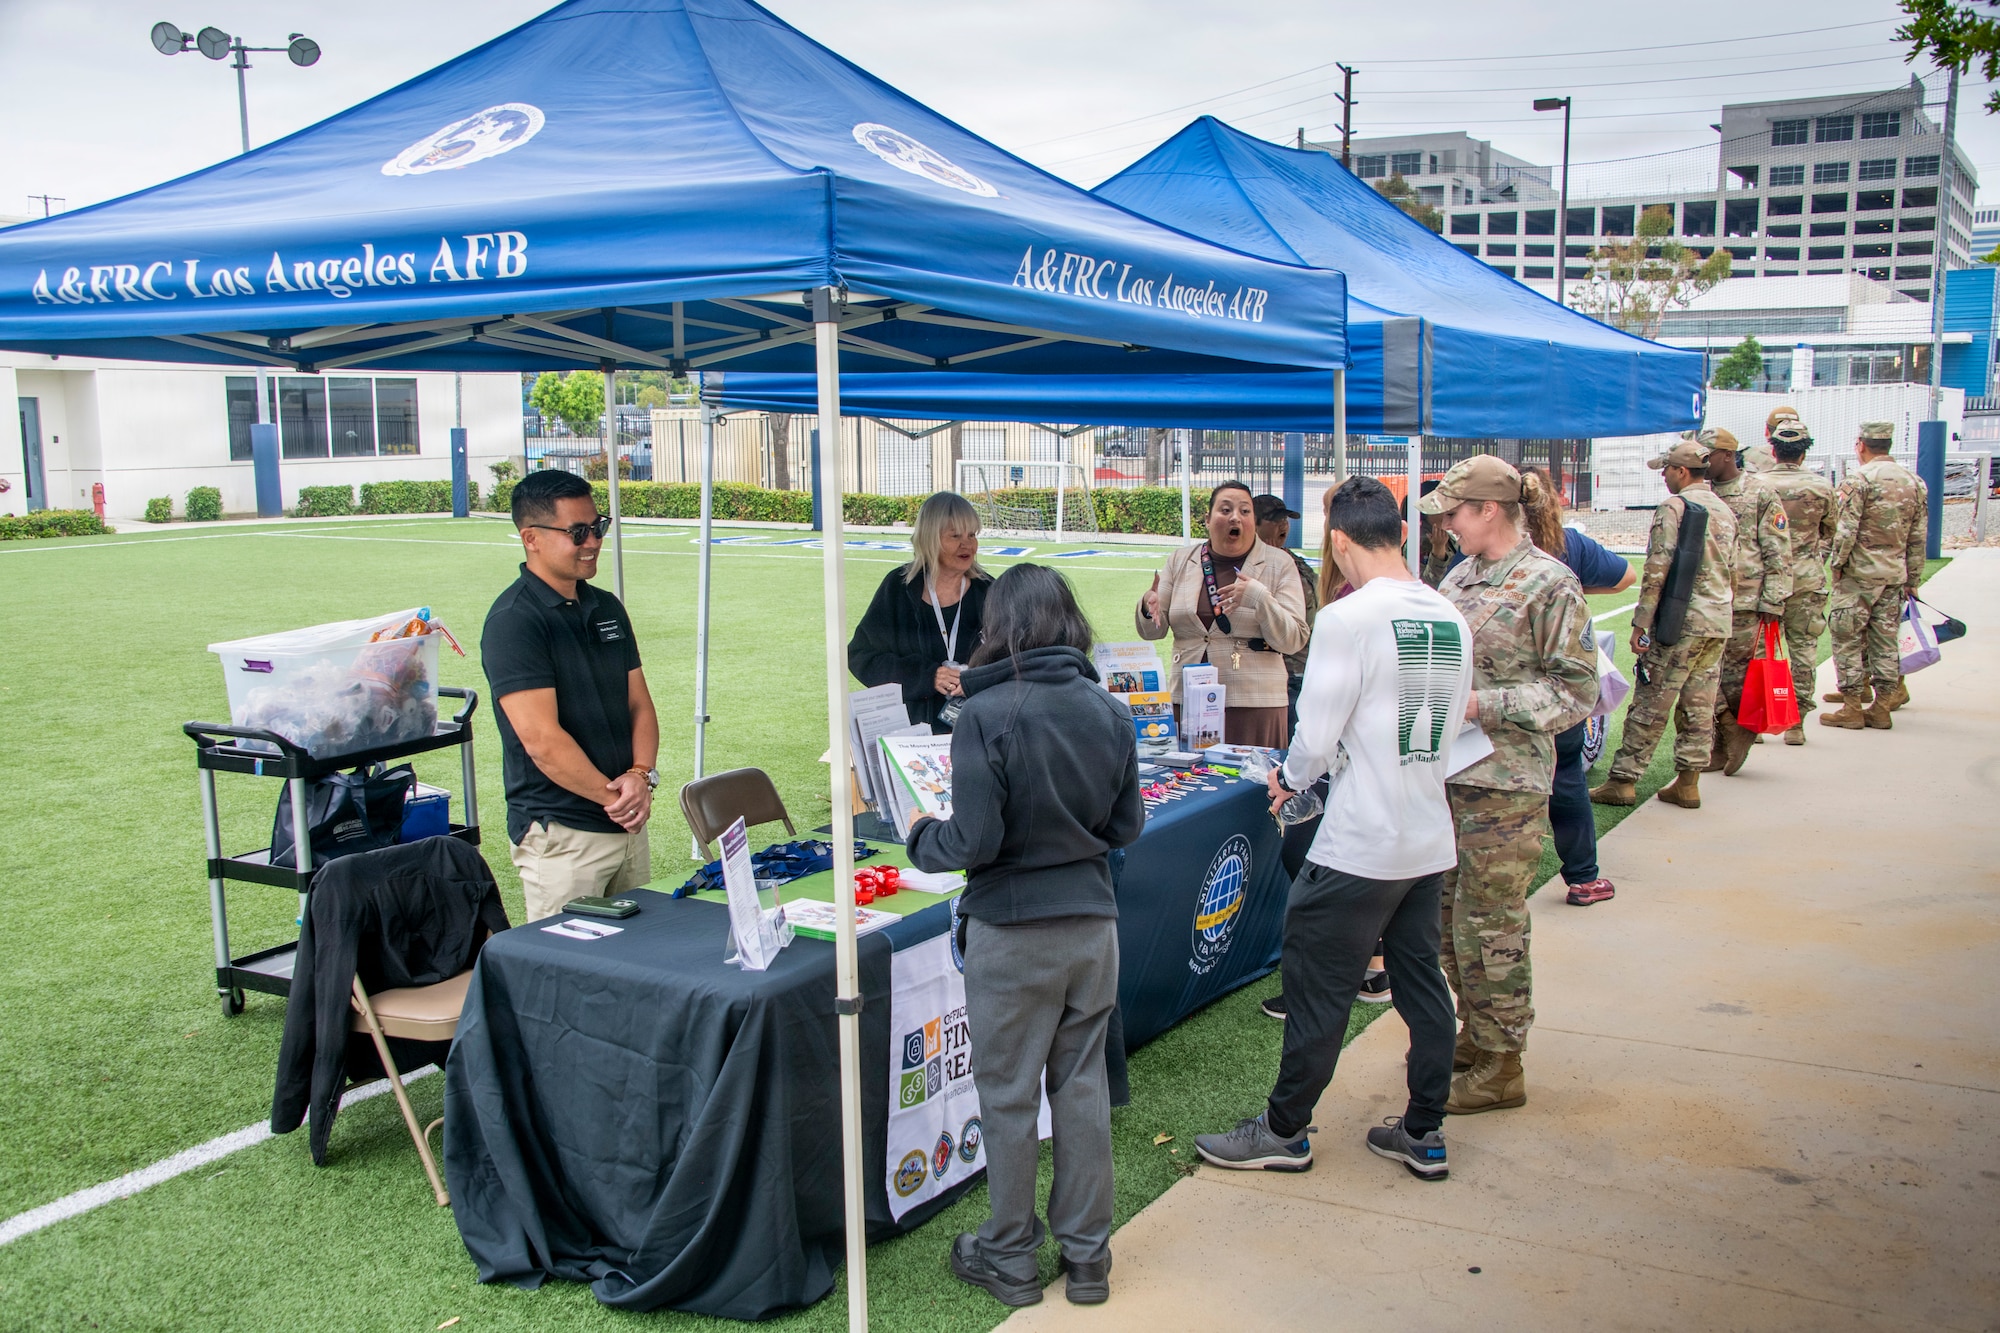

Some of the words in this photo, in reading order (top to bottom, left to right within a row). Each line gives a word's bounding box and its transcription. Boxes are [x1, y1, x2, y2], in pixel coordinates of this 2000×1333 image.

[33, 261, 177, 304] A&FRC
[183, 258, 255, 299] Los
[266, 243, 416, 298] Angeles
[429, 230, 529, 282] AFB
[1012, 244, 1117, 300] A&FRC
[1117, 264, 1154, 306] Los
[1157, 272, 1225, 319] Angeles
[1228, 285, 1269, 323] AFB
[1200, 844, 1232, 903] MILITARY
[1239, 843, 1250, 882] FAMILY
